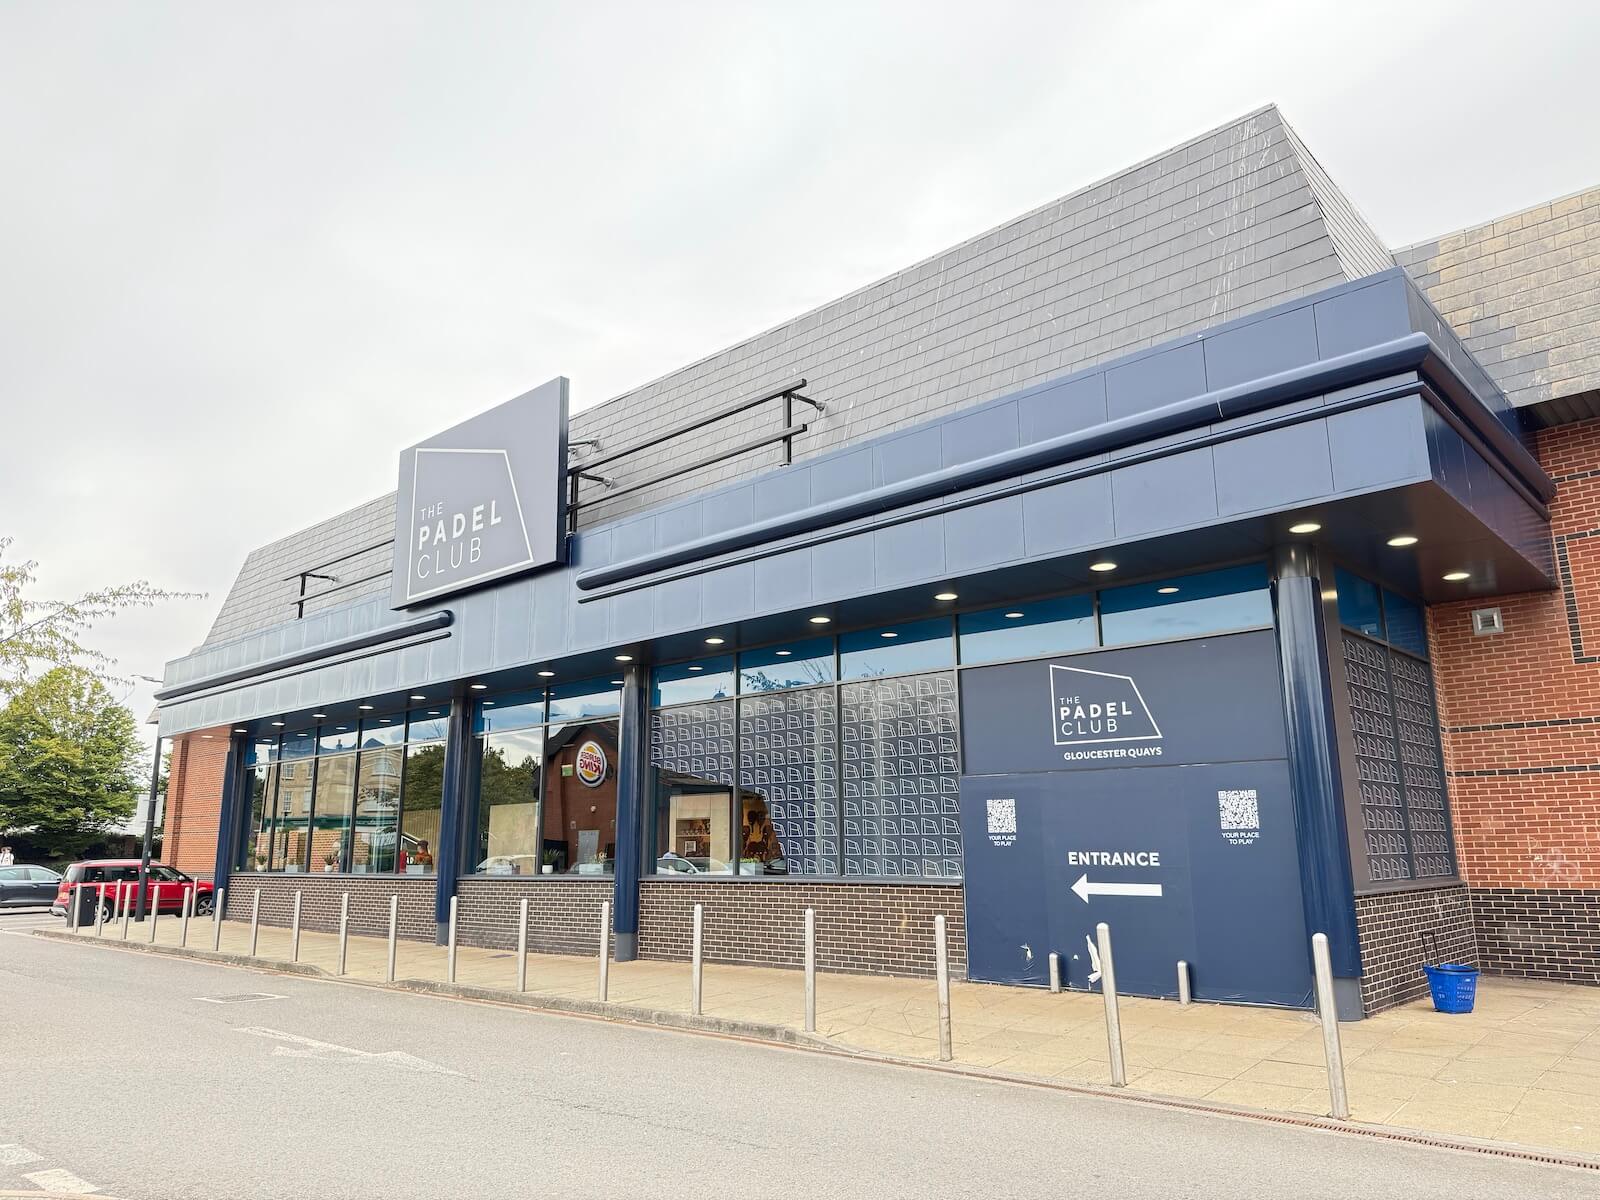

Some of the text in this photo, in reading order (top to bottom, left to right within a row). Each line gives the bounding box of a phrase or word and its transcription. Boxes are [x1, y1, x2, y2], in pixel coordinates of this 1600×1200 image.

[420, 502, 443, 521] THE
[418, 500, 502, 550] PADEL
[417, 537, 481, 579] CLUB
[1060, 696, 1080, 705] THE
[1060, 701, 1132, 720] PADEL
[1061, 719, 1118, 736] CLUB
[1063, 747, 1162, 761] GLOUCESTER QUAYS
[1068, 851, 1161, 867] ENTRANCE
